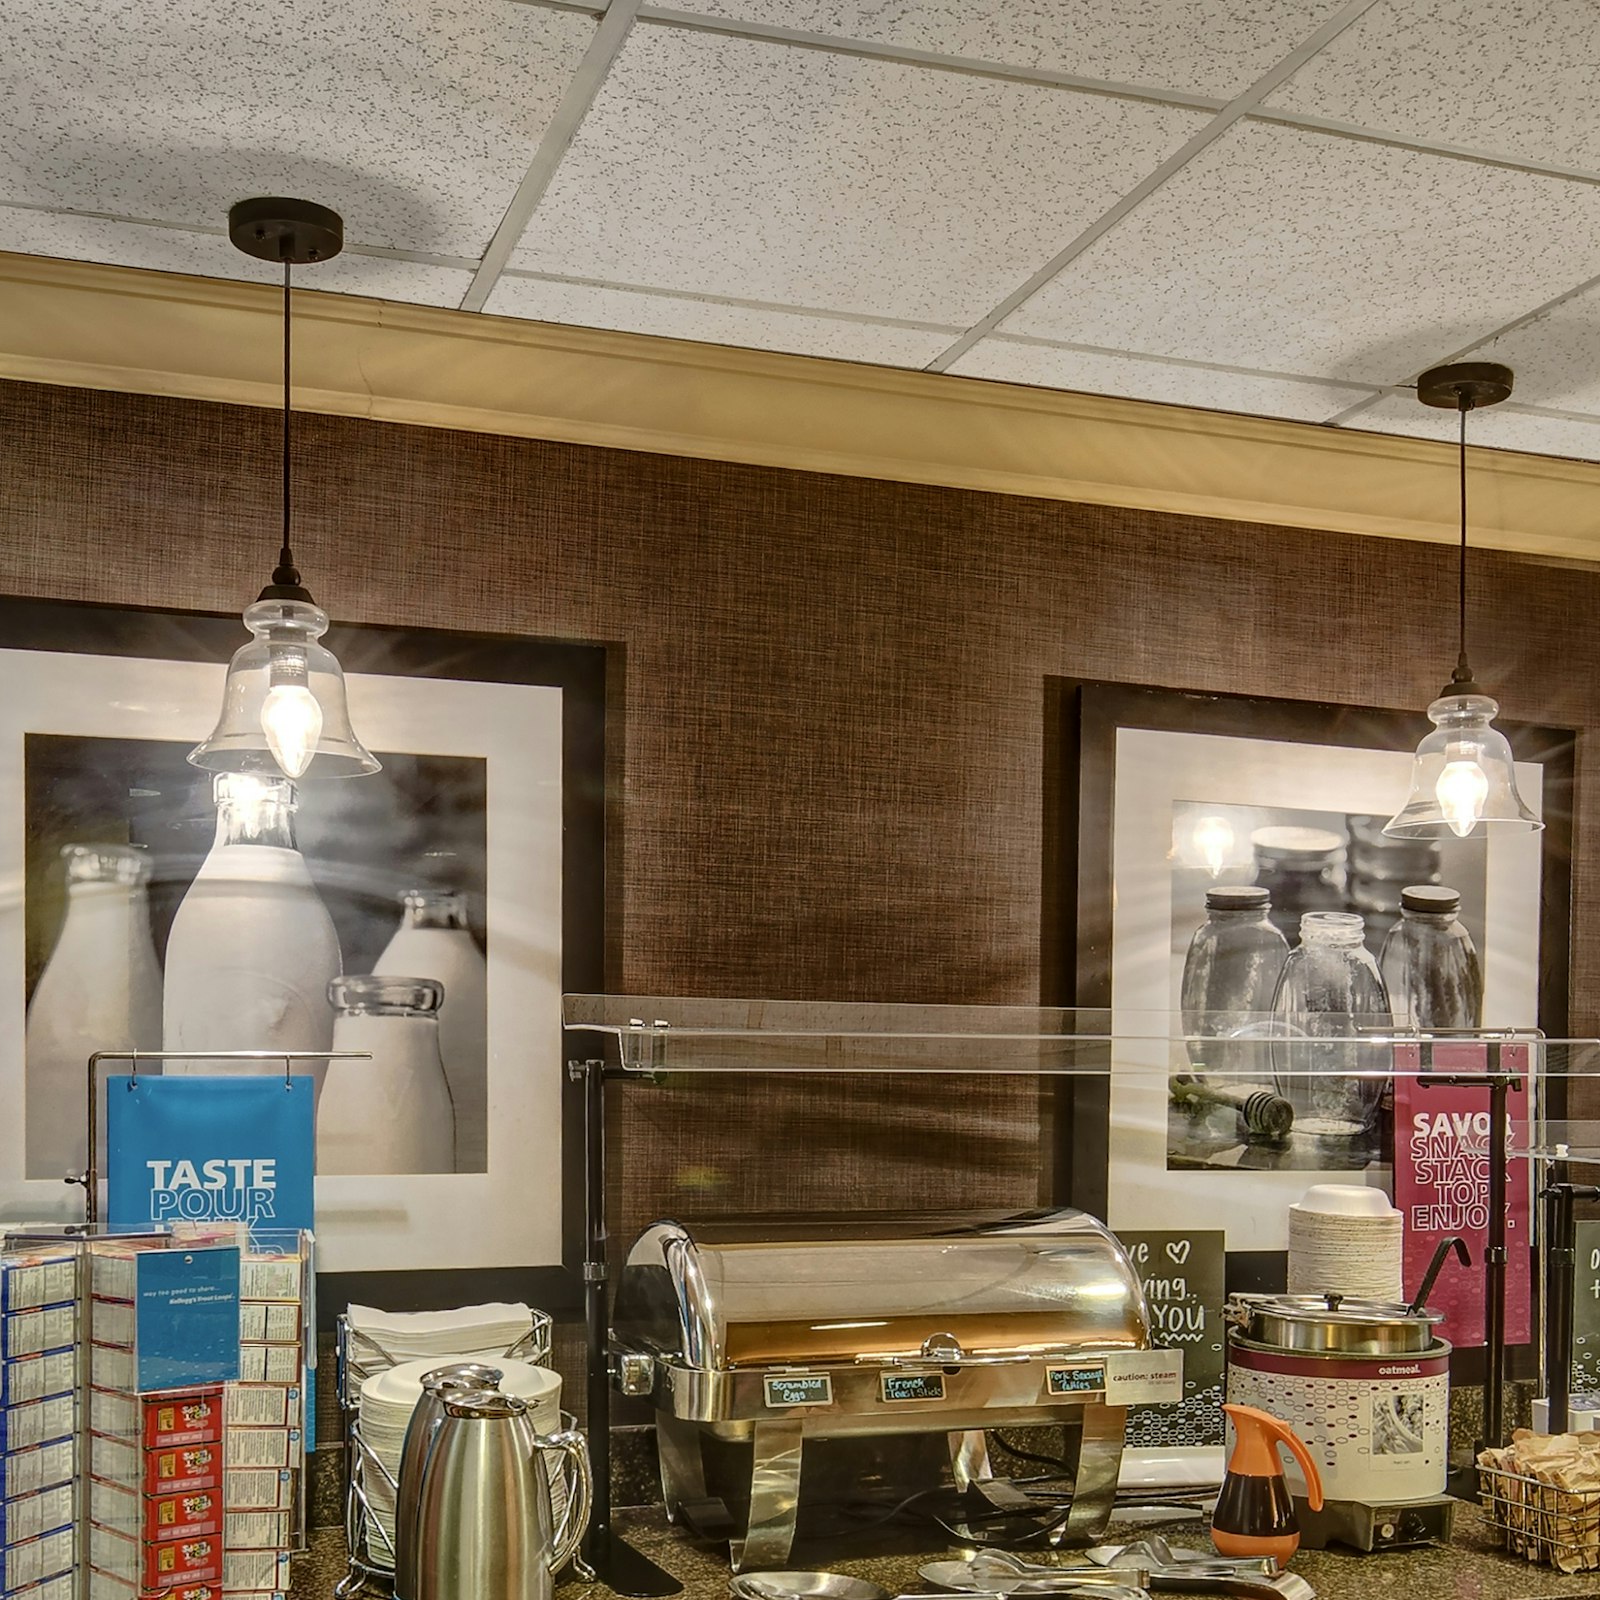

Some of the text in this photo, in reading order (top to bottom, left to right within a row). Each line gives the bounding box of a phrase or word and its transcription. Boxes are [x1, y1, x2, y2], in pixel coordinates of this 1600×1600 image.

[146, 1159, 277, 1190] TASTE
[1434, 1181, 1489, 1207] TOP
[150, 1186, 276, 1221] POUR
[1113, 1371, 1177, 1382] caution: steam
[772, 1379, 822, 1390] Scrambled
[888, 1378, 925, 1390] French
[783, 1390, 806, 1402] Eggs
